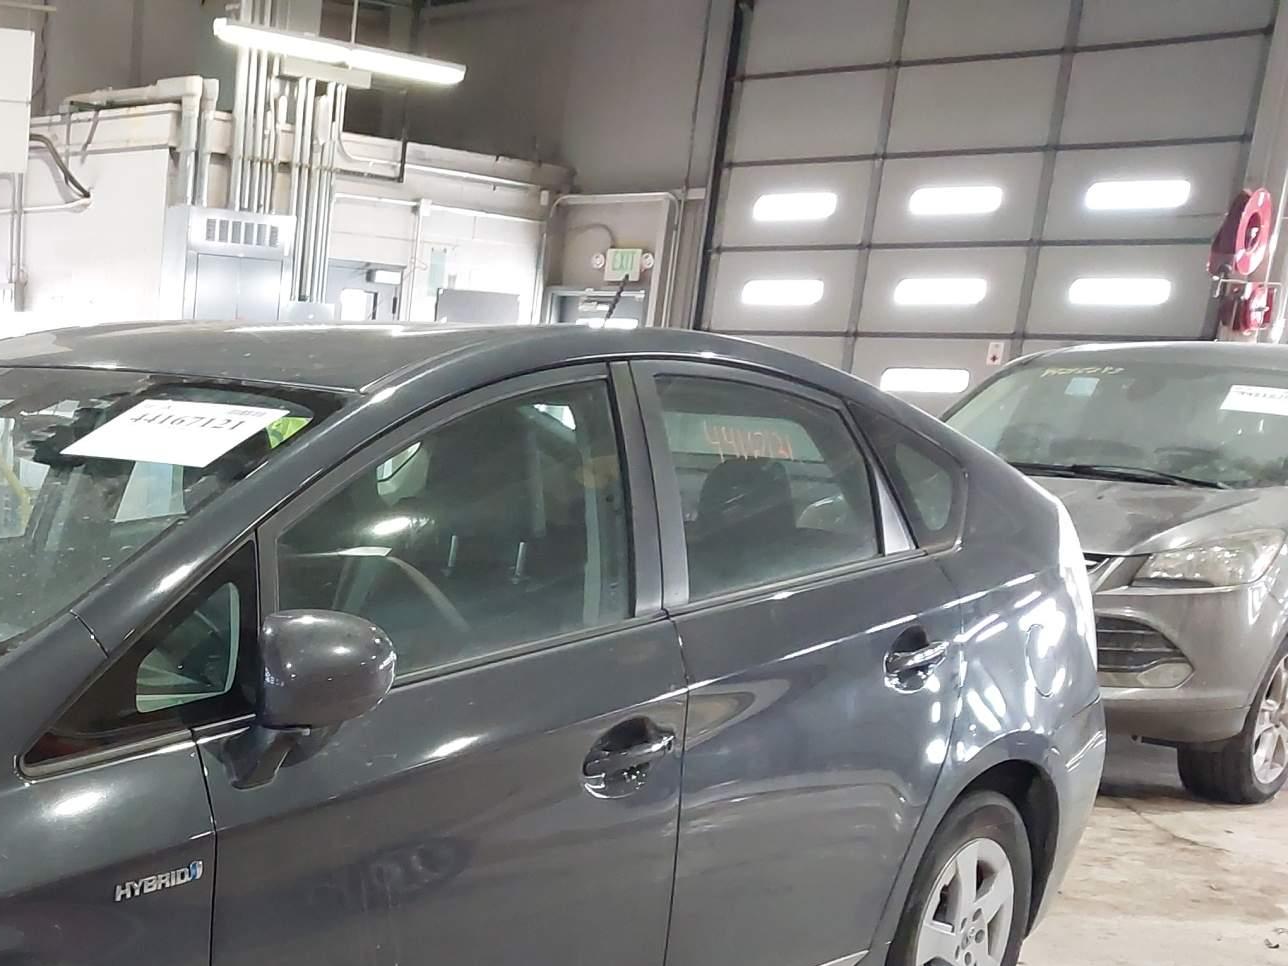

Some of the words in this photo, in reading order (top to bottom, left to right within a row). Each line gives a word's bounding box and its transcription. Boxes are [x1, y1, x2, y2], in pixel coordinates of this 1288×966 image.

[611, 250, 637, 271] EXIT
[129, 411, 247, 431] 44167121
[115, 867, 191, 901] HYBRID
